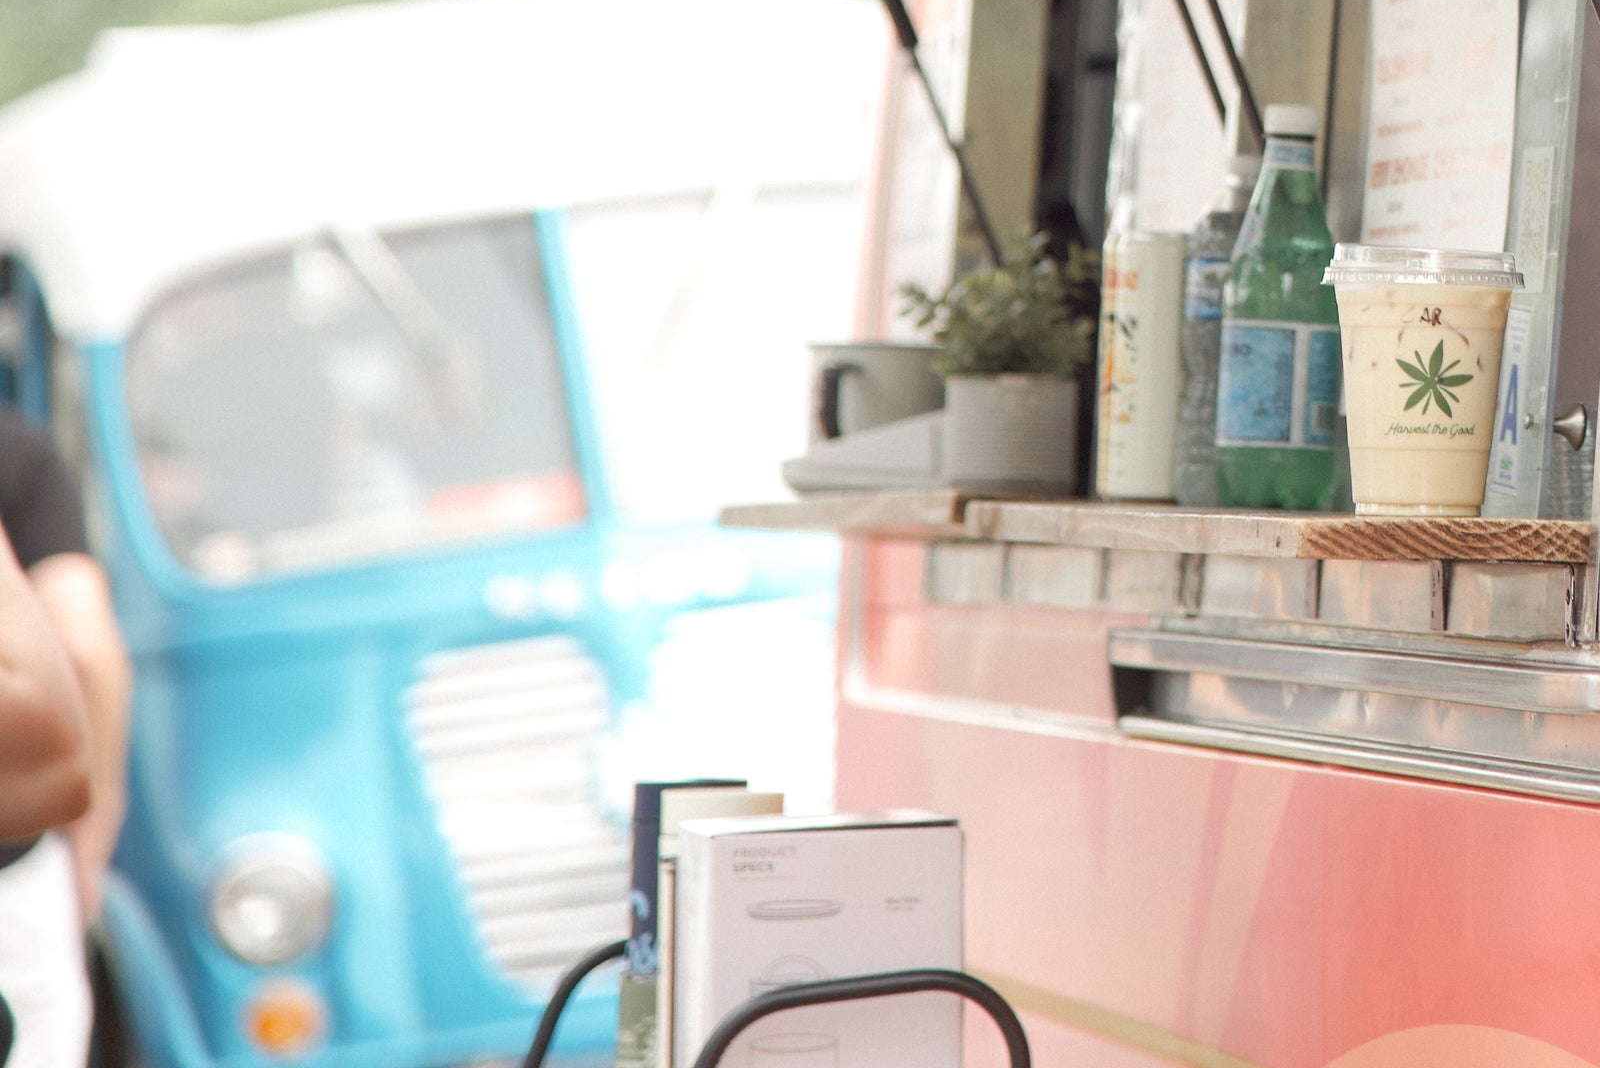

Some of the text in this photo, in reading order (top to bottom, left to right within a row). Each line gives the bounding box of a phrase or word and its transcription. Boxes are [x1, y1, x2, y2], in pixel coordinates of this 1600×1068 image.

[1500, 365, 1518, 444] A
[1386, 422, 1475, 438] Harvest the Good
